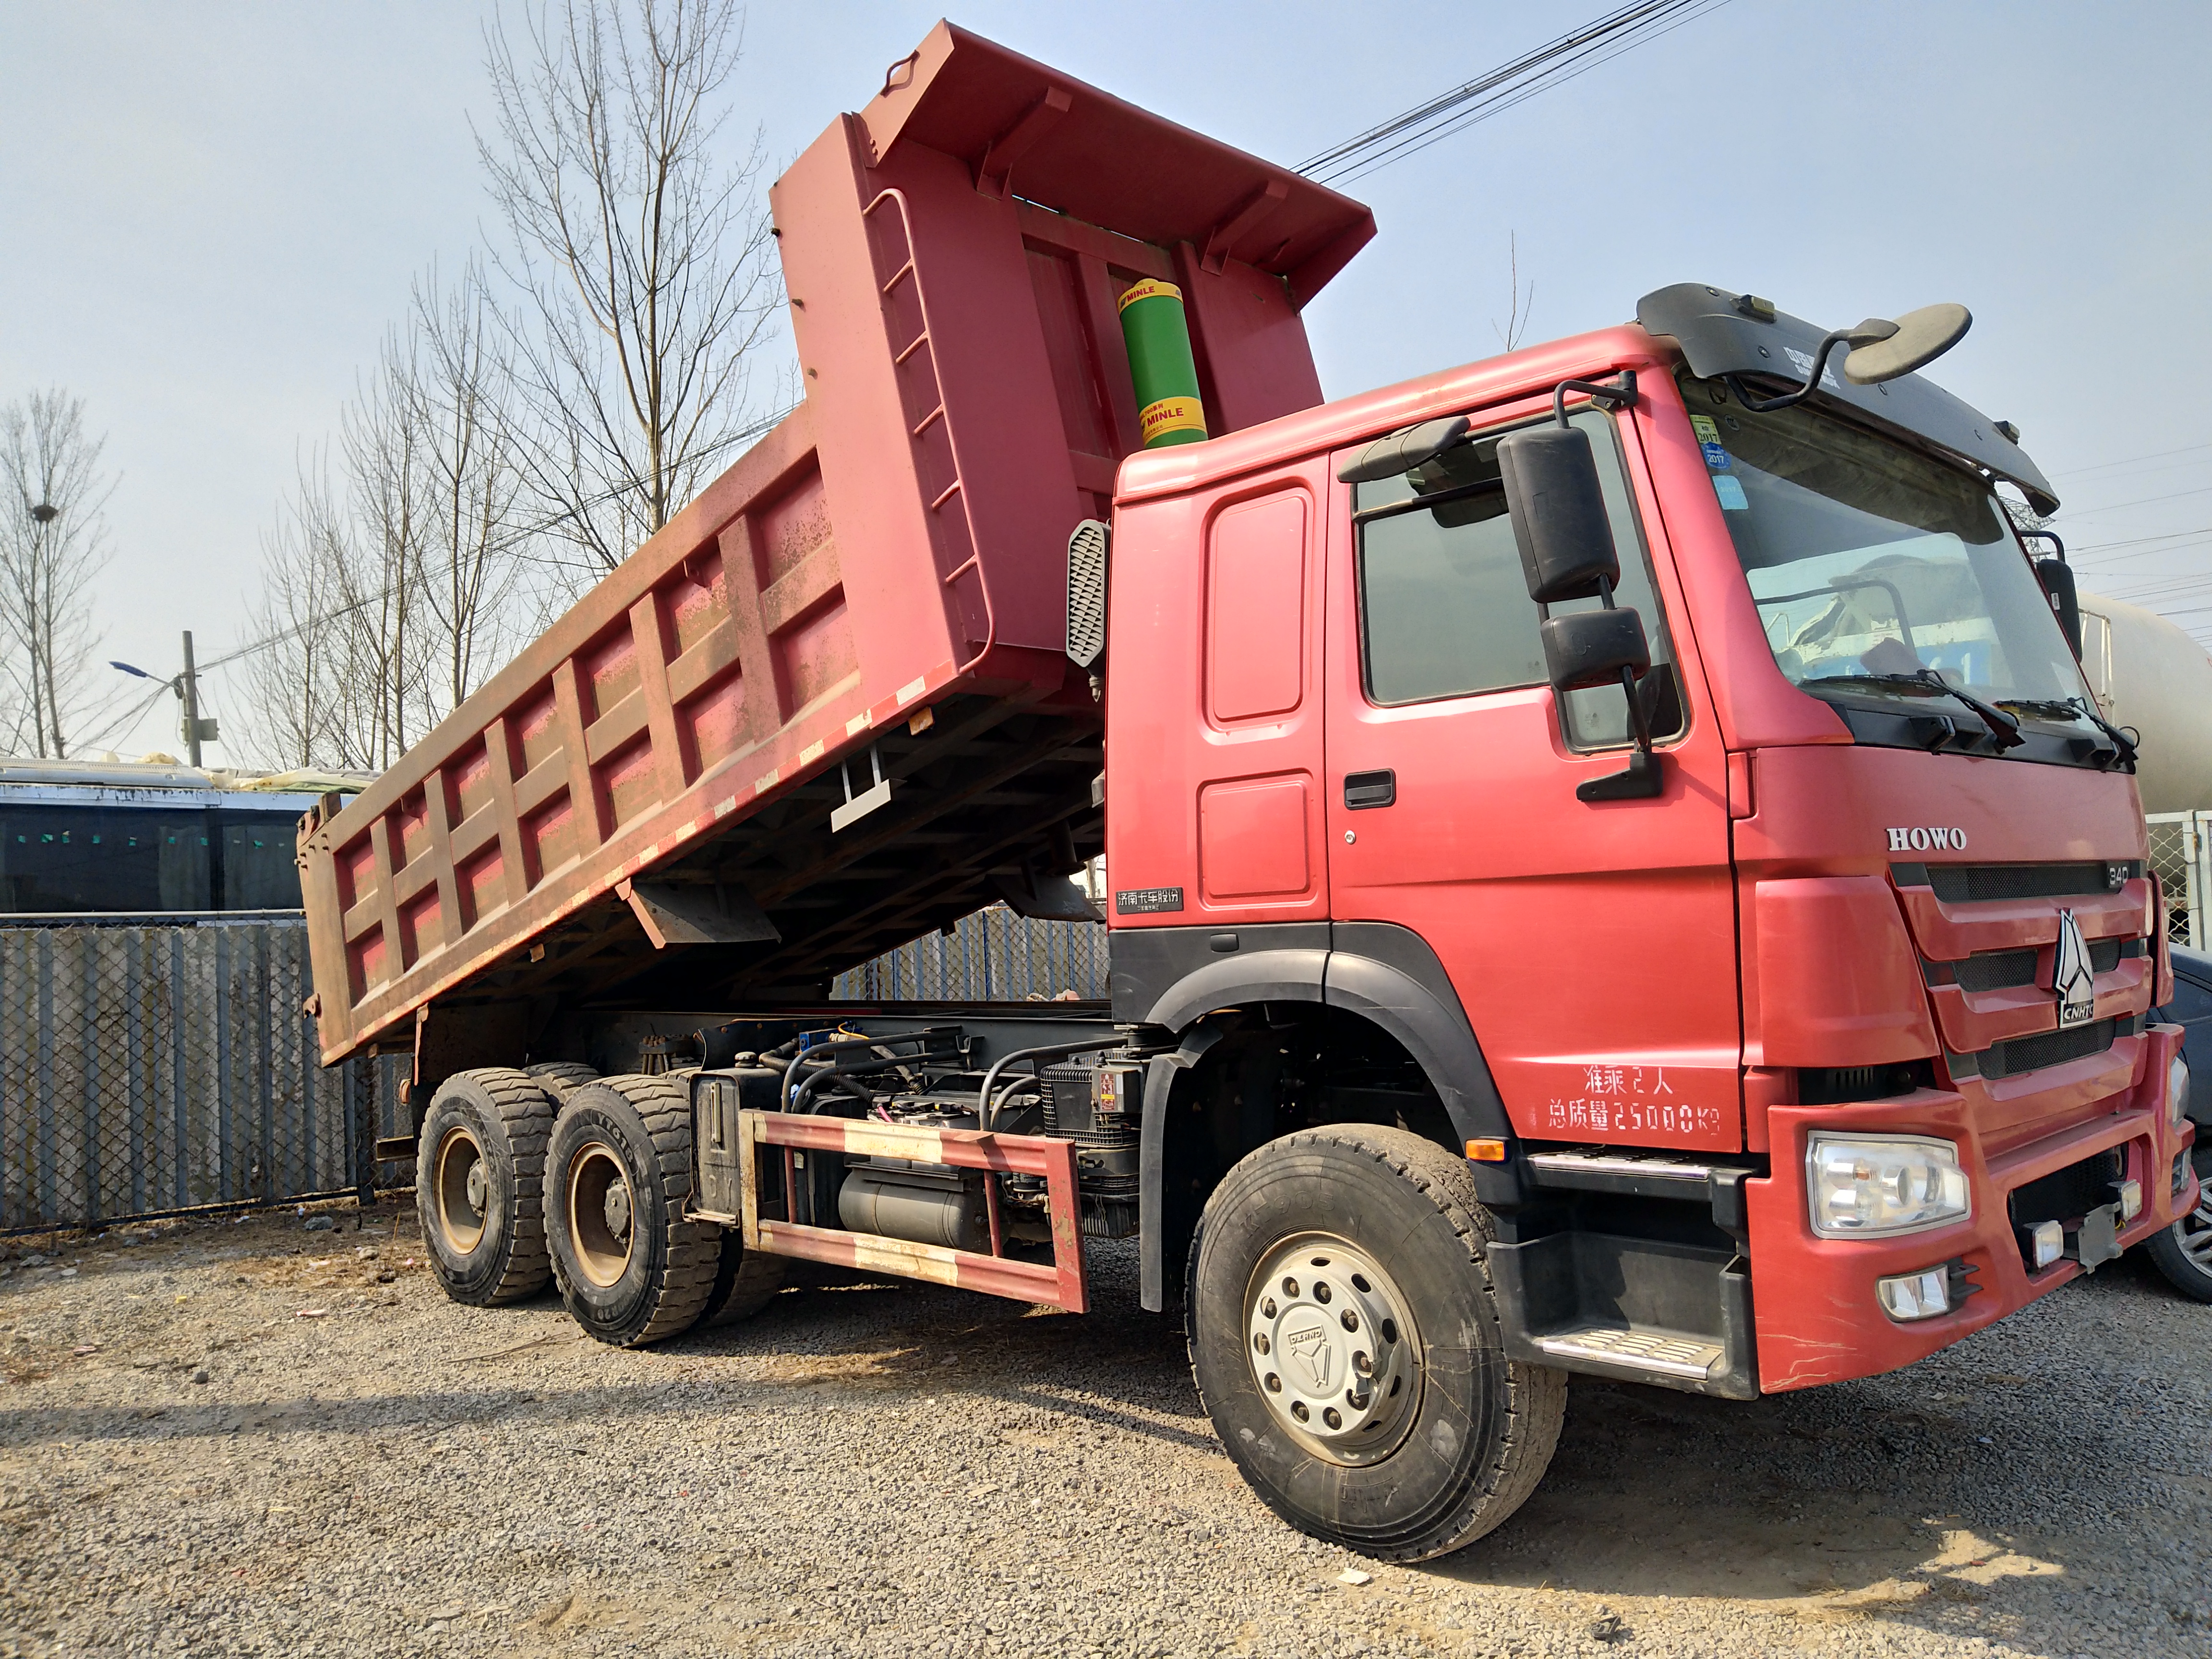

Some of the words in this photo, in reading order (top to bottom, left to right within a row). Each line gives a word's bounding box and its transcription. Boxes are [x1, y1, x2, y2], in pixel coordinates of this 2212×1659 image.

[1126, 286, 1155, 302] MINLE
[1147, 407, 1184, 427] MINLE
[1698, 433, 1717, 442] 2017
[1707, 454, 1724, 464] 2017
[1886, 827, 1967, 852] HOWO
[2109, 866, 2128, 885] 340
[1118, 889, 1179, 906] 济南卡车股份
[2064, 1003, 2093, 1020] CNHTC
[597, 1112, 633, 1163] YT618
